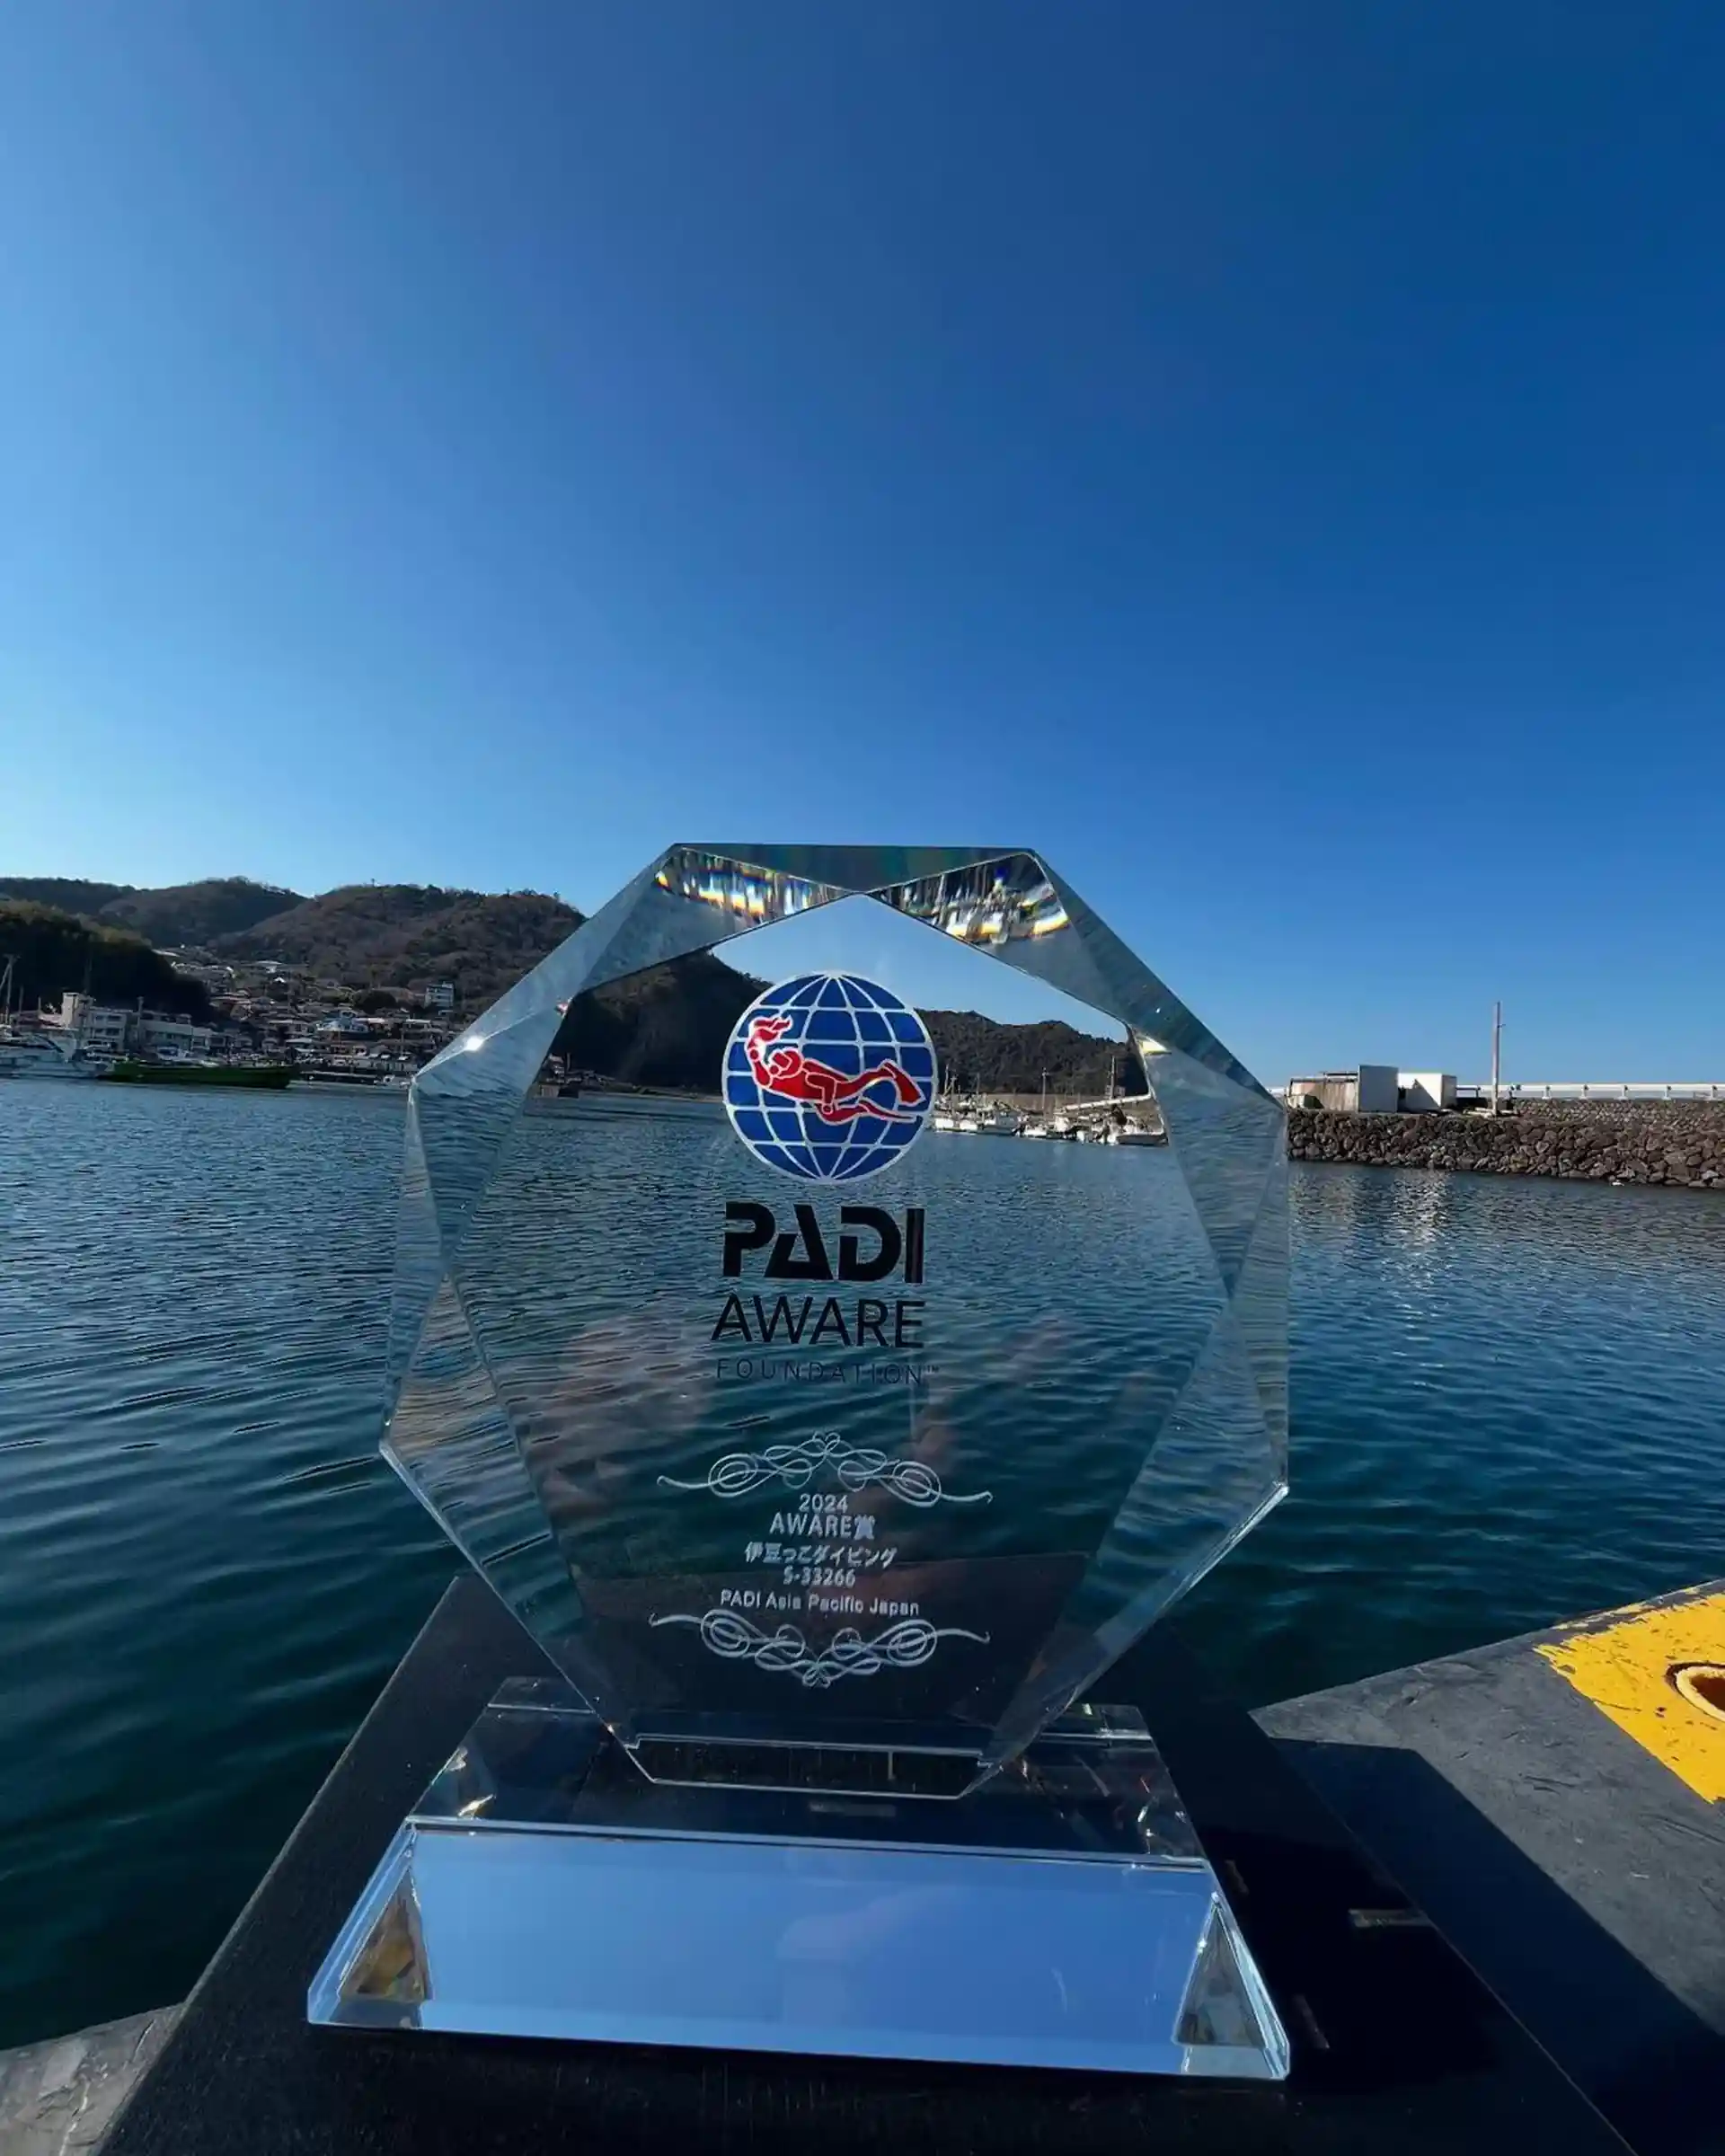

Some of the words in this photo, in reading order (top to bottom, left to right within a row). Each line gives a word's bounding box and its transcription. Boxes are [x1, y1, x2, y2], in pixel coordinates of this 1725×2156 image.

[722, 1200, 925, 1284] PADI
[711, 1293, 926, 1348] AWARE
[798, 1493, 849, 1514] 2024
[720, 1588, 762, 1608] PADI
[765, 1589, 801, 1611] Asia
[808, 1593, 864, 1614] Pacific
[869, 1597, 920, 1617] Japan
